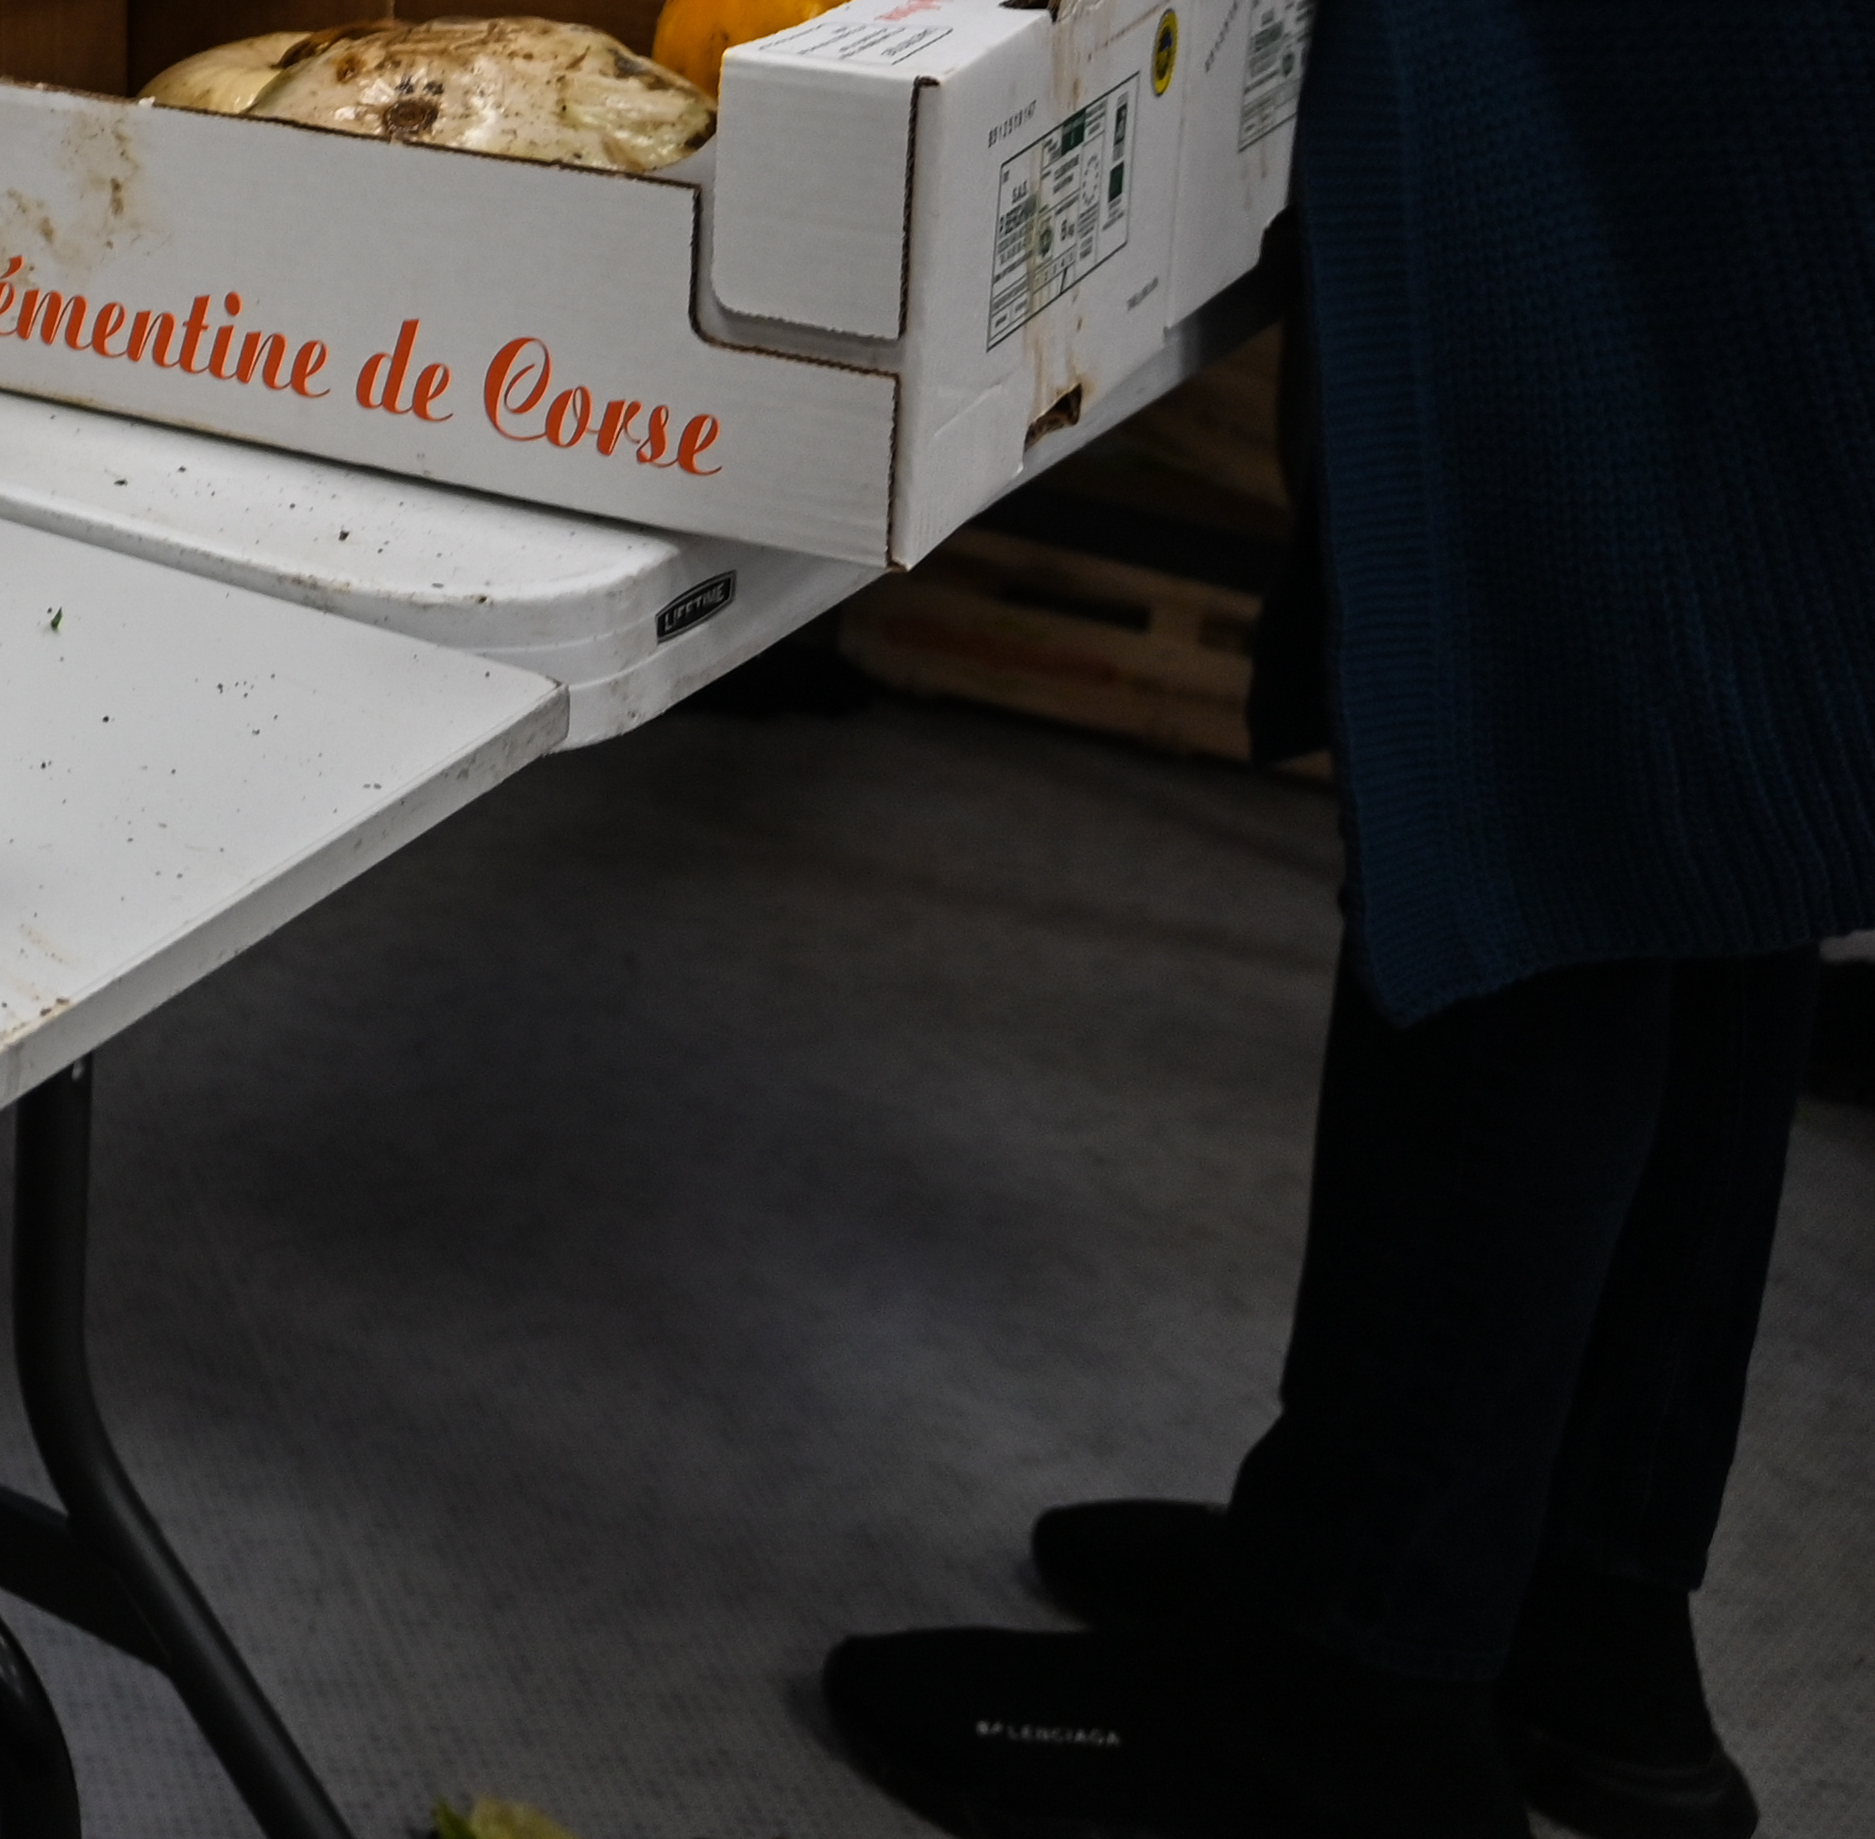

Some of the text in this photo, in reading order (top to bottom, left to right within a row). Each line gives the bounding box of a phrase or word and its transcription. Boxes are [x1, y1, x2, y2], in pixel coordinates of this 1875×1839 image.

[355, 318, 453, 424] de
[484, 336, 723, 477] Corse
[664, 582, 726, 631] LIFETIME
